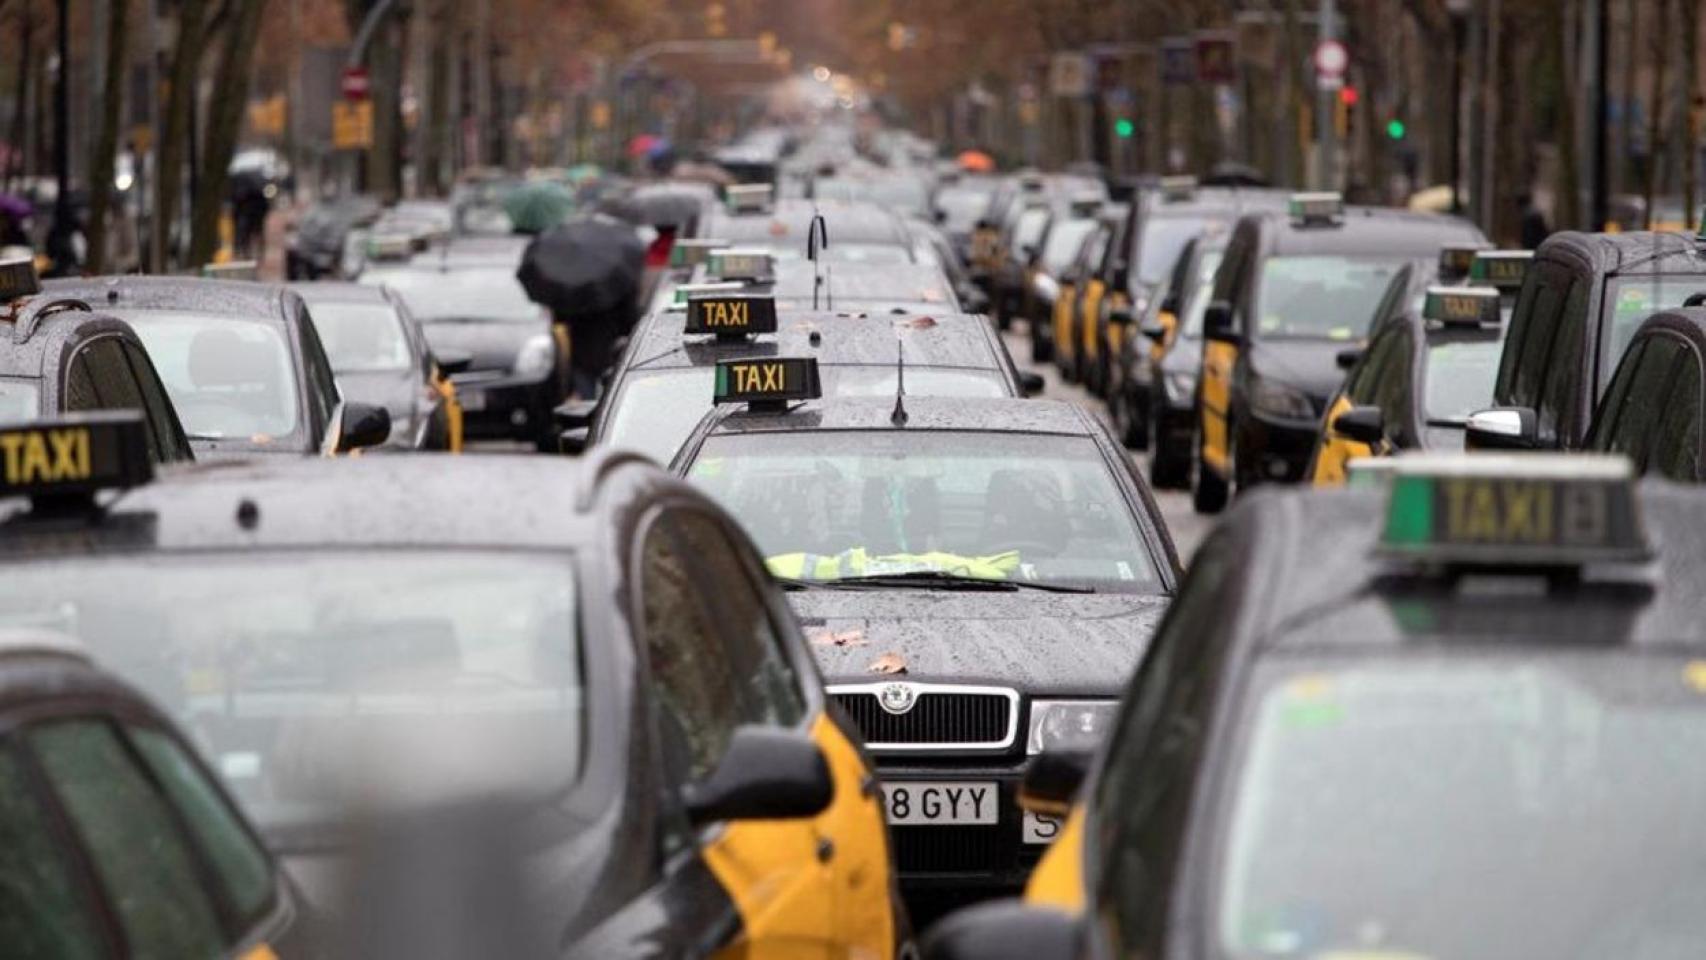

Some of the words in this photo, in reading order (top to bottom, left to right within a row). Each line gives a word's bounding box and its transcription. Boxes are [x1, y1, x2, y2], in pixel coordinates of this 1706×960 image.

[703, 301, 748, 326] TAXI
[732, 363, 784, 393] TAXI
[0, 428, 90, 484] TAXI
[1444, 480, 1553, 541] TAXI
[880, 788, 910, 819] 8
[921, 787, 987, 820] GYY
